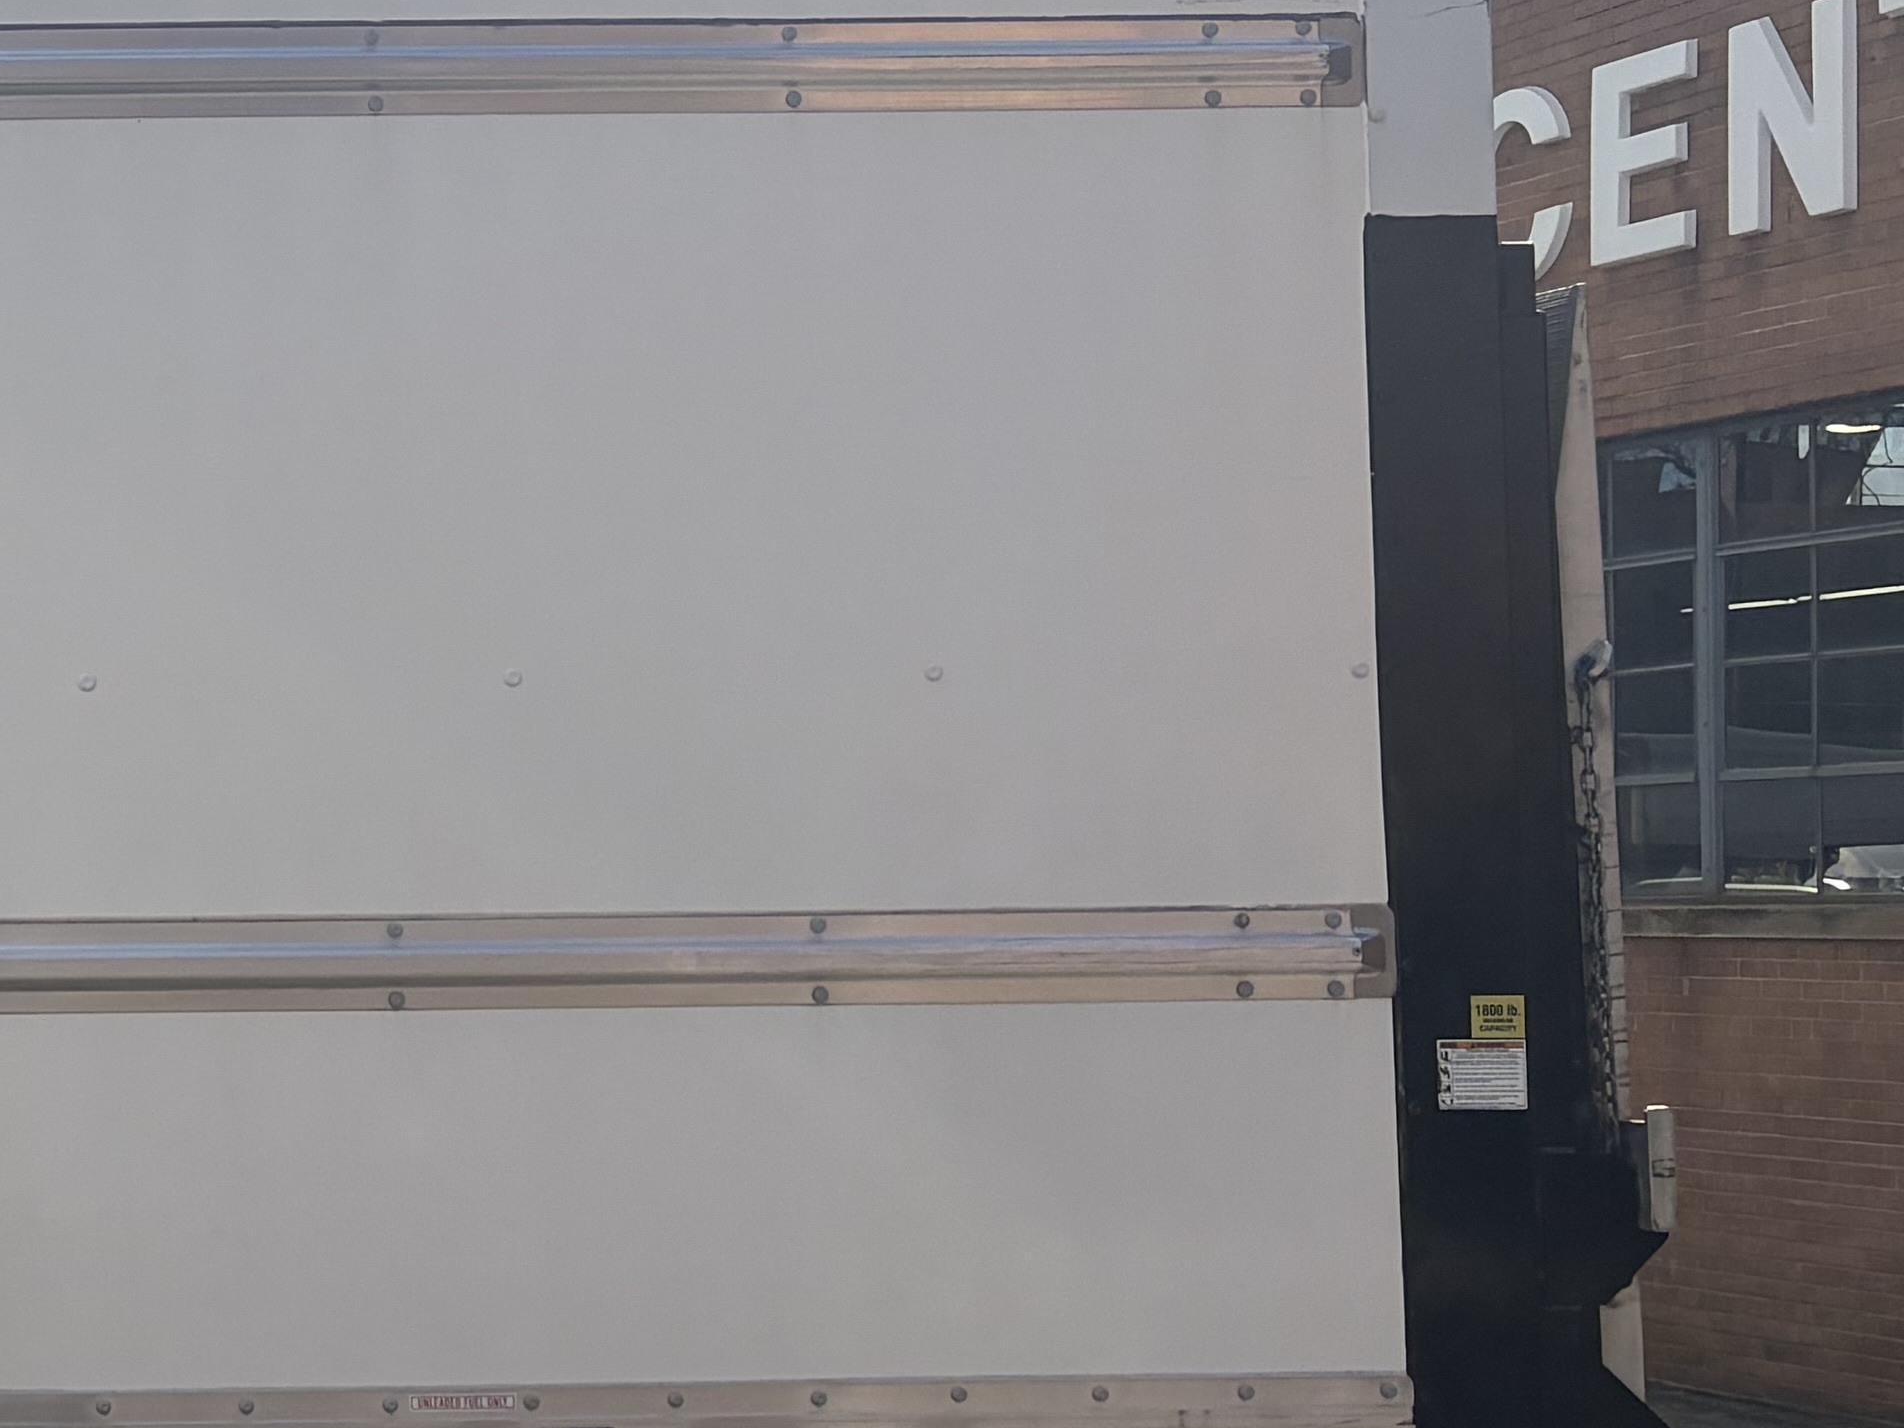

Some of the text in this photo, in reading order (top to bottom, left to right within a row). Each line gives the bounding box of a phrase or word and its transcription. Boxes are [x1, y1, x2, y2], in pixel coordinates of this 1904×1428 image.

[417, 1395, 508, 1410] UNLEADED FUEL ONLY
